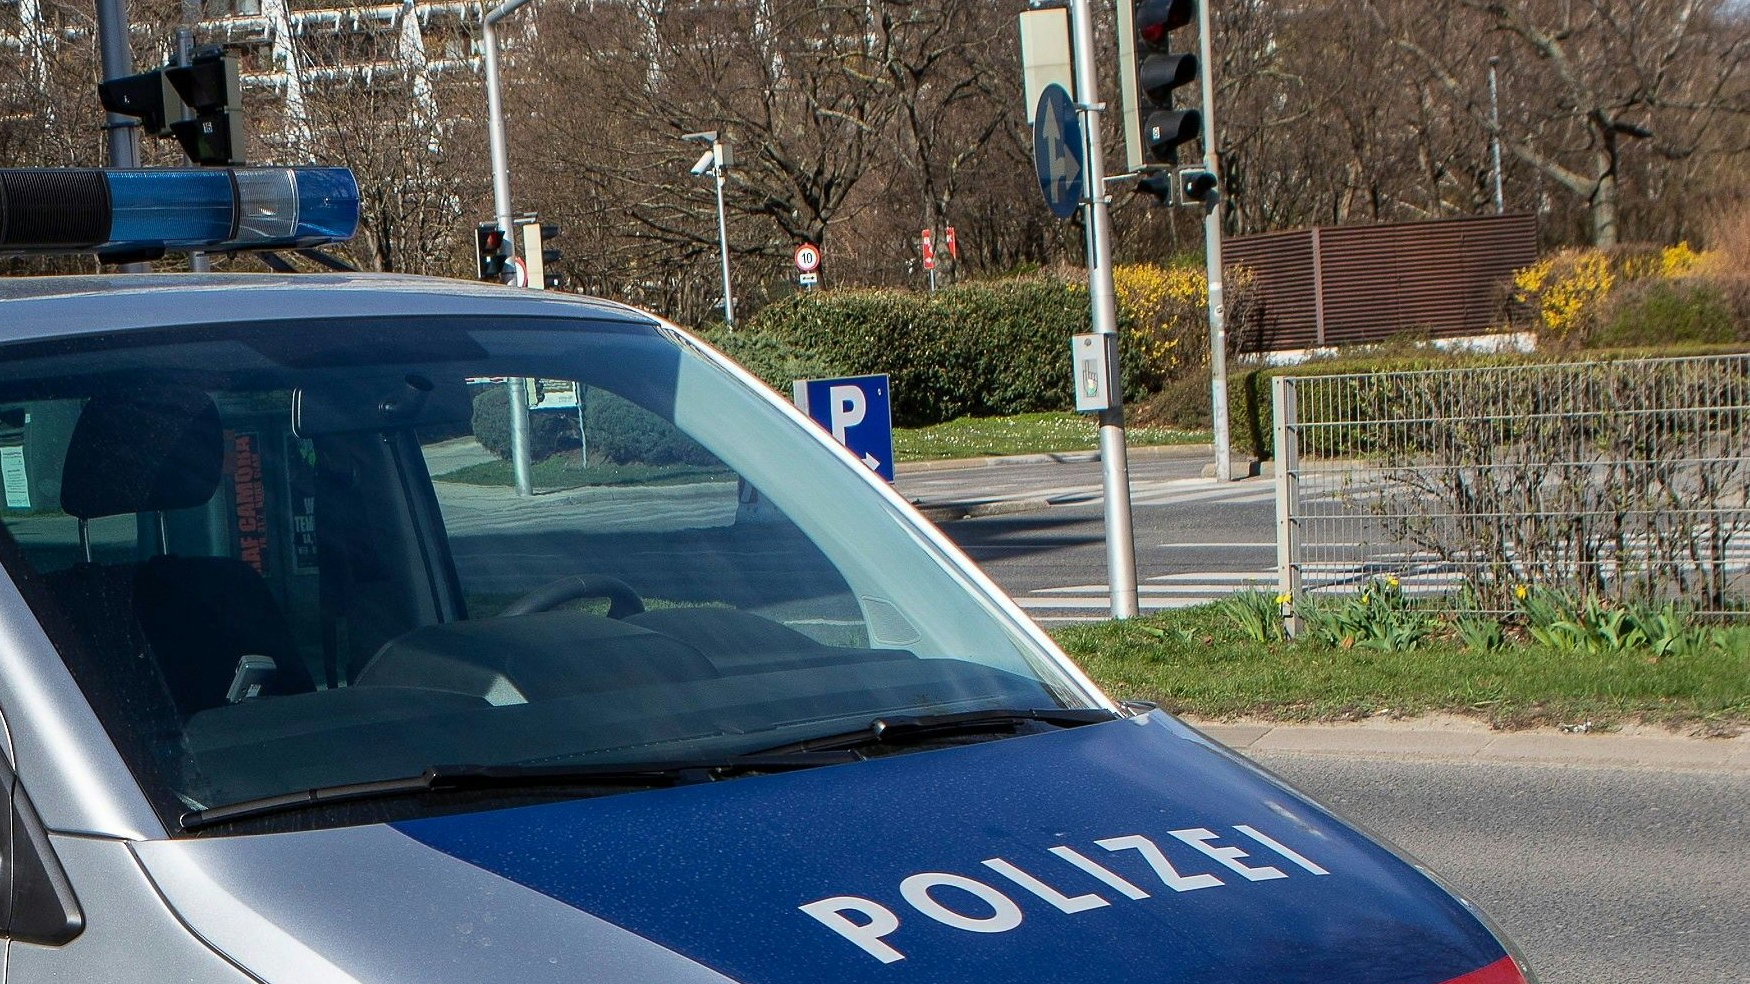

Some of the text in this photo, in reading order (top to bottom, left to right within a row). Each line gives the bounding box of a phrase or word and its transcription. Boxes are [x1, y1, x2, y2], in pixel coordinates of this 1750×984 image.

[801, 252, 813, 264] 10
[830, 385, 866, 446] P
[240, 537, 262, 573] AF
[798, 823, 1331, 964] POLIZEI
